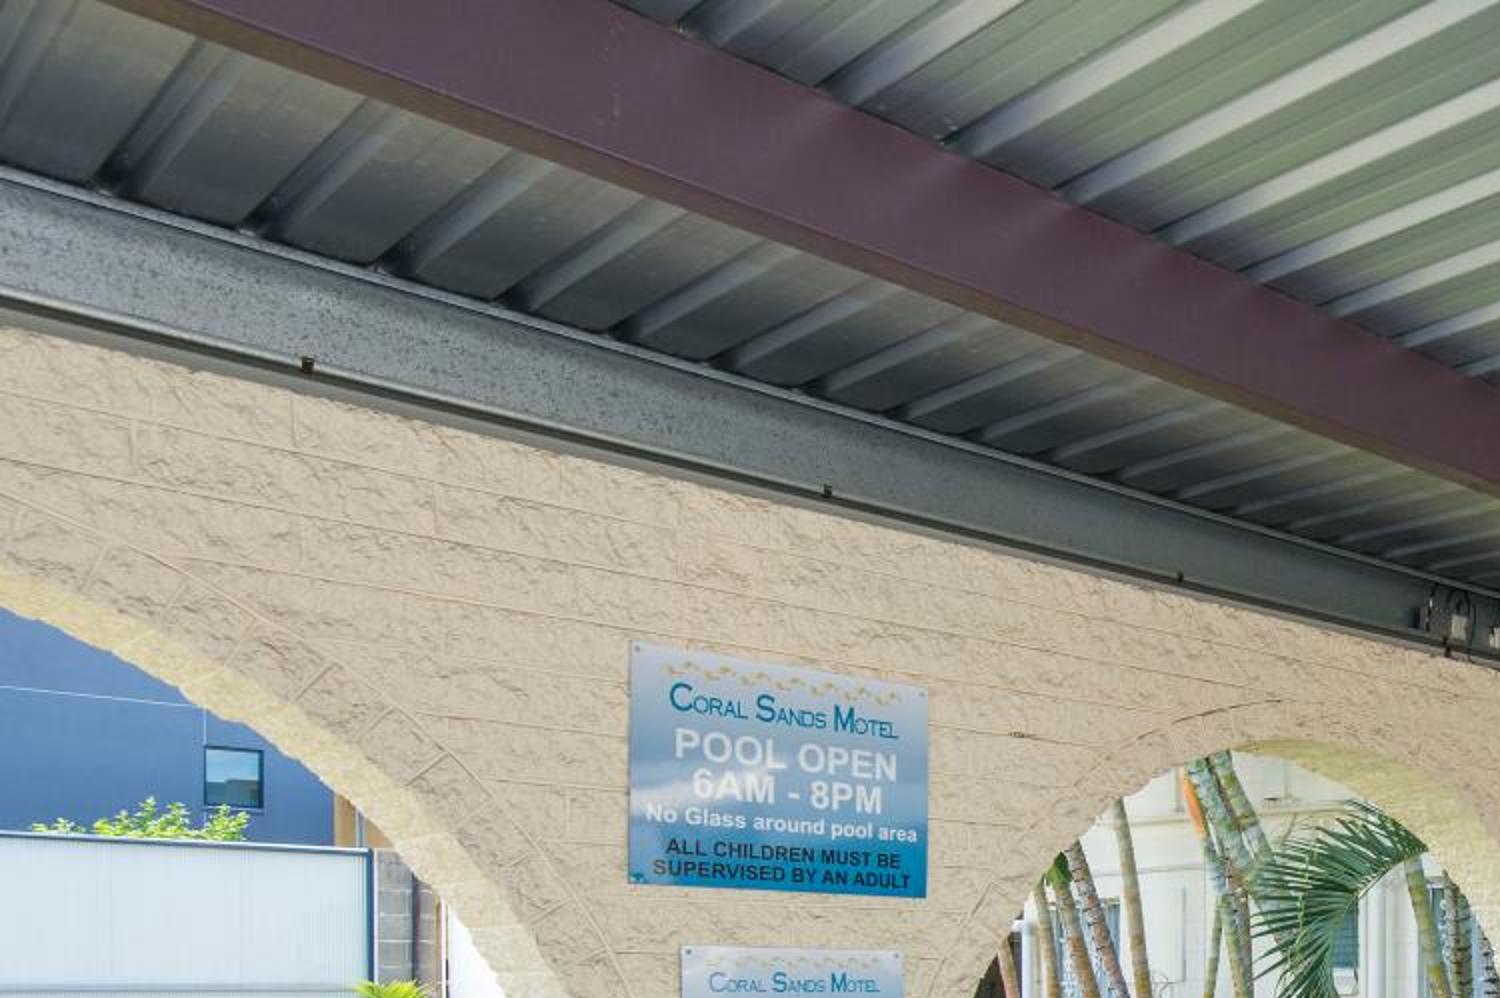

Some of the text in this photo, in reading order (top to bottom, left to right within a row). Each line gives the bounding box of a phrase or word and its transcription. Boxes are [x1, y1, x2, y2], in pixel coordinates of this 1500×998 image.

[669, 682, 899, 740] CORAL SANDS MOTEL
[674, 727, 897, 782] POOL OPEN
[692, 768, 775, 805] 6AM
[810, 781, 882, 815] 8PM
[645, 804, 918, 843] No Glass around pool area
[665, 838, 901, 870] ALL CHILDREN MUST BE
[653, 859, 912, 889] SUPERVISED BY AN ADULT
[709, 971, 880, 993] CORAL SANDS MOTEL
